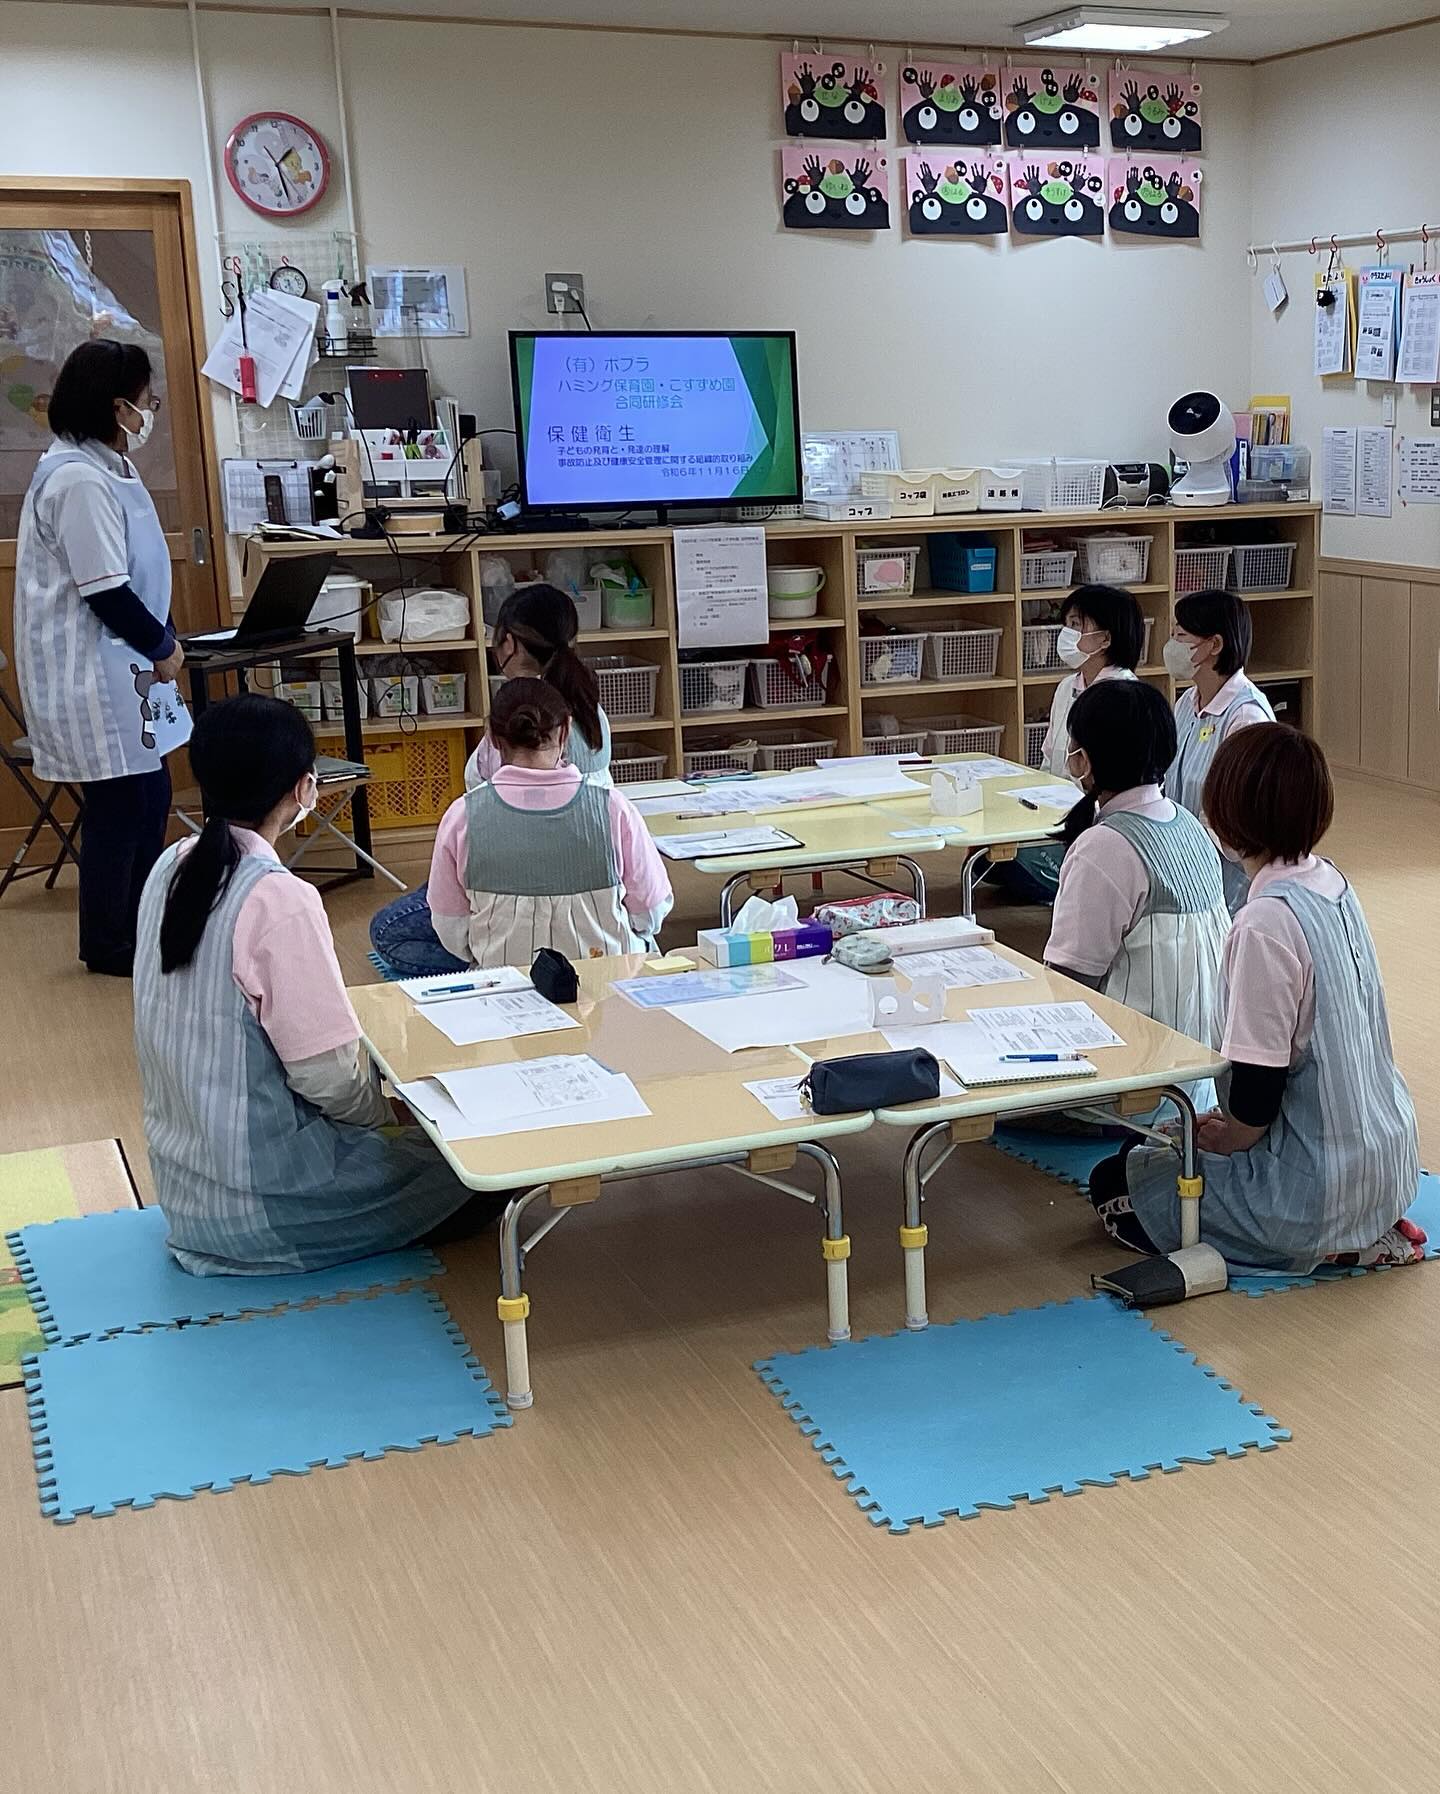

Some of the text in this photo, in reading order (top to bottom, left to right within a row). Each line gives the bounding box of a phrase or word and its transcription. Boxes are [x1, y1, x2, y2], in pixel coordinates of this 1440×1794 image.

[250, 124, 259, 133] 11
[236, 138, 246, 147] 10
[306, 142, 314, 151] 2
[615, 394, 684, 410] 合同研修会
[547, 424, 635, 443] 保健衛生
